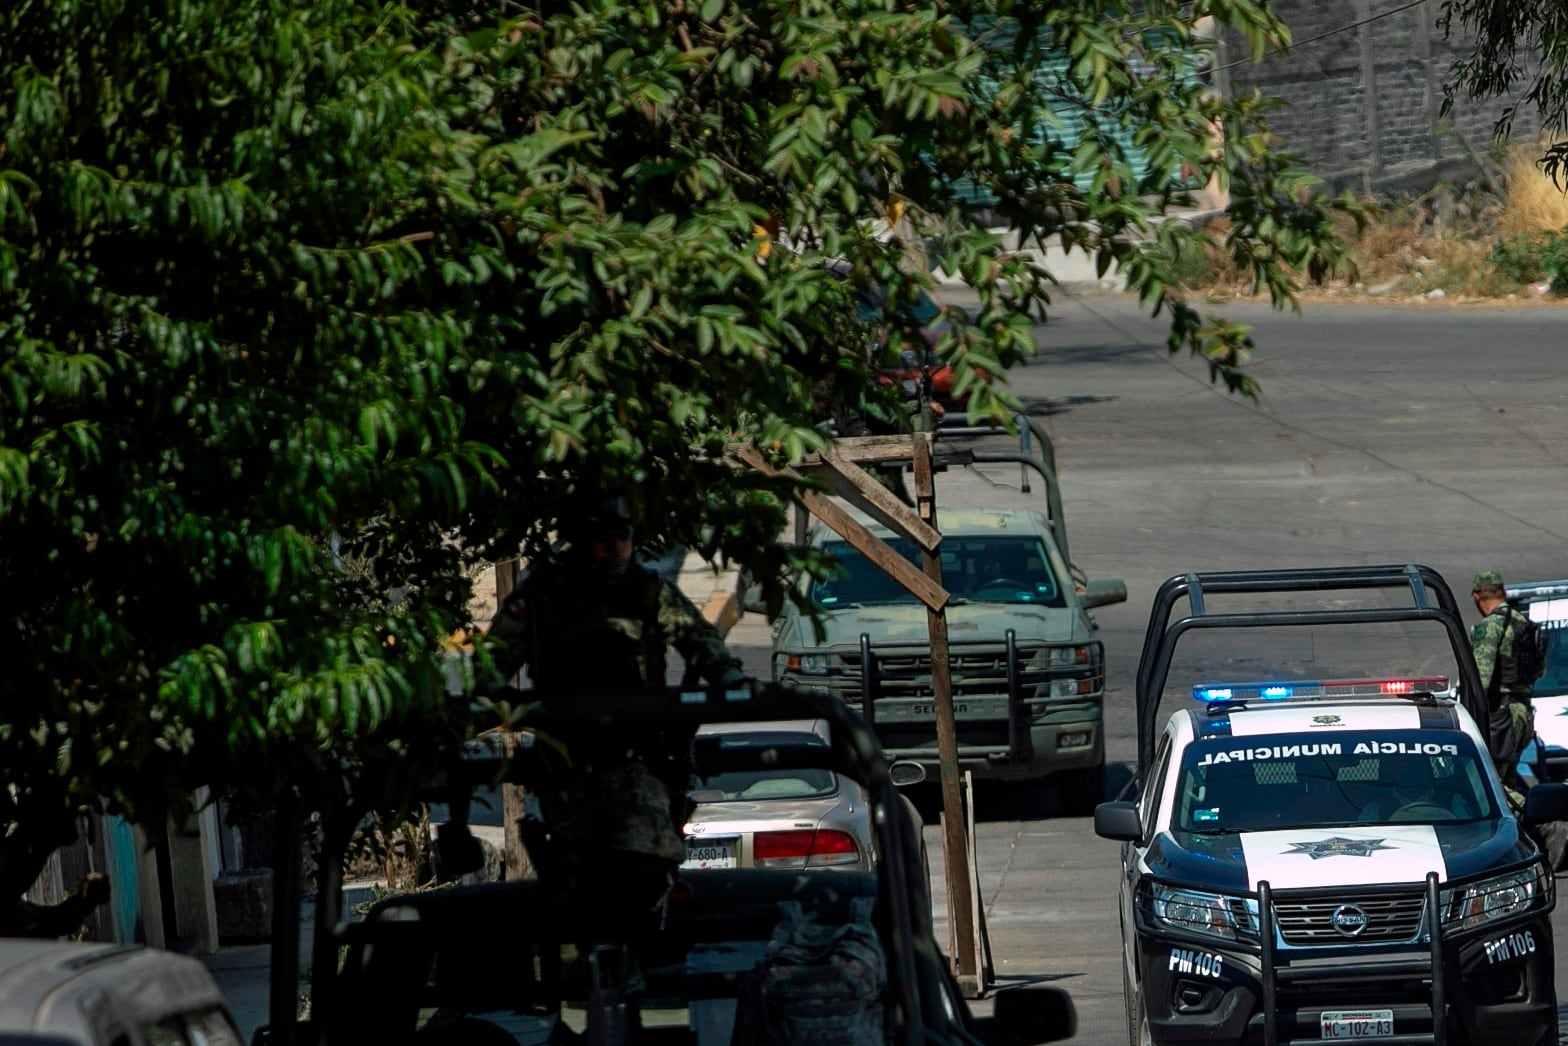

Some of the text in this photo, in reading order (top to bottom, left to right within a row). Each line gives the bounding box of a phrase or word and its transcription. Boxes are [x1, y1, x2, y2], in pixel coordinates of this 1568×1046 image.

[1483, 930, 1536, 964] PM106
[1168, 949, 1223, 978] PM106
[1325, 1020, 1391, 1037] MC-102-A3
